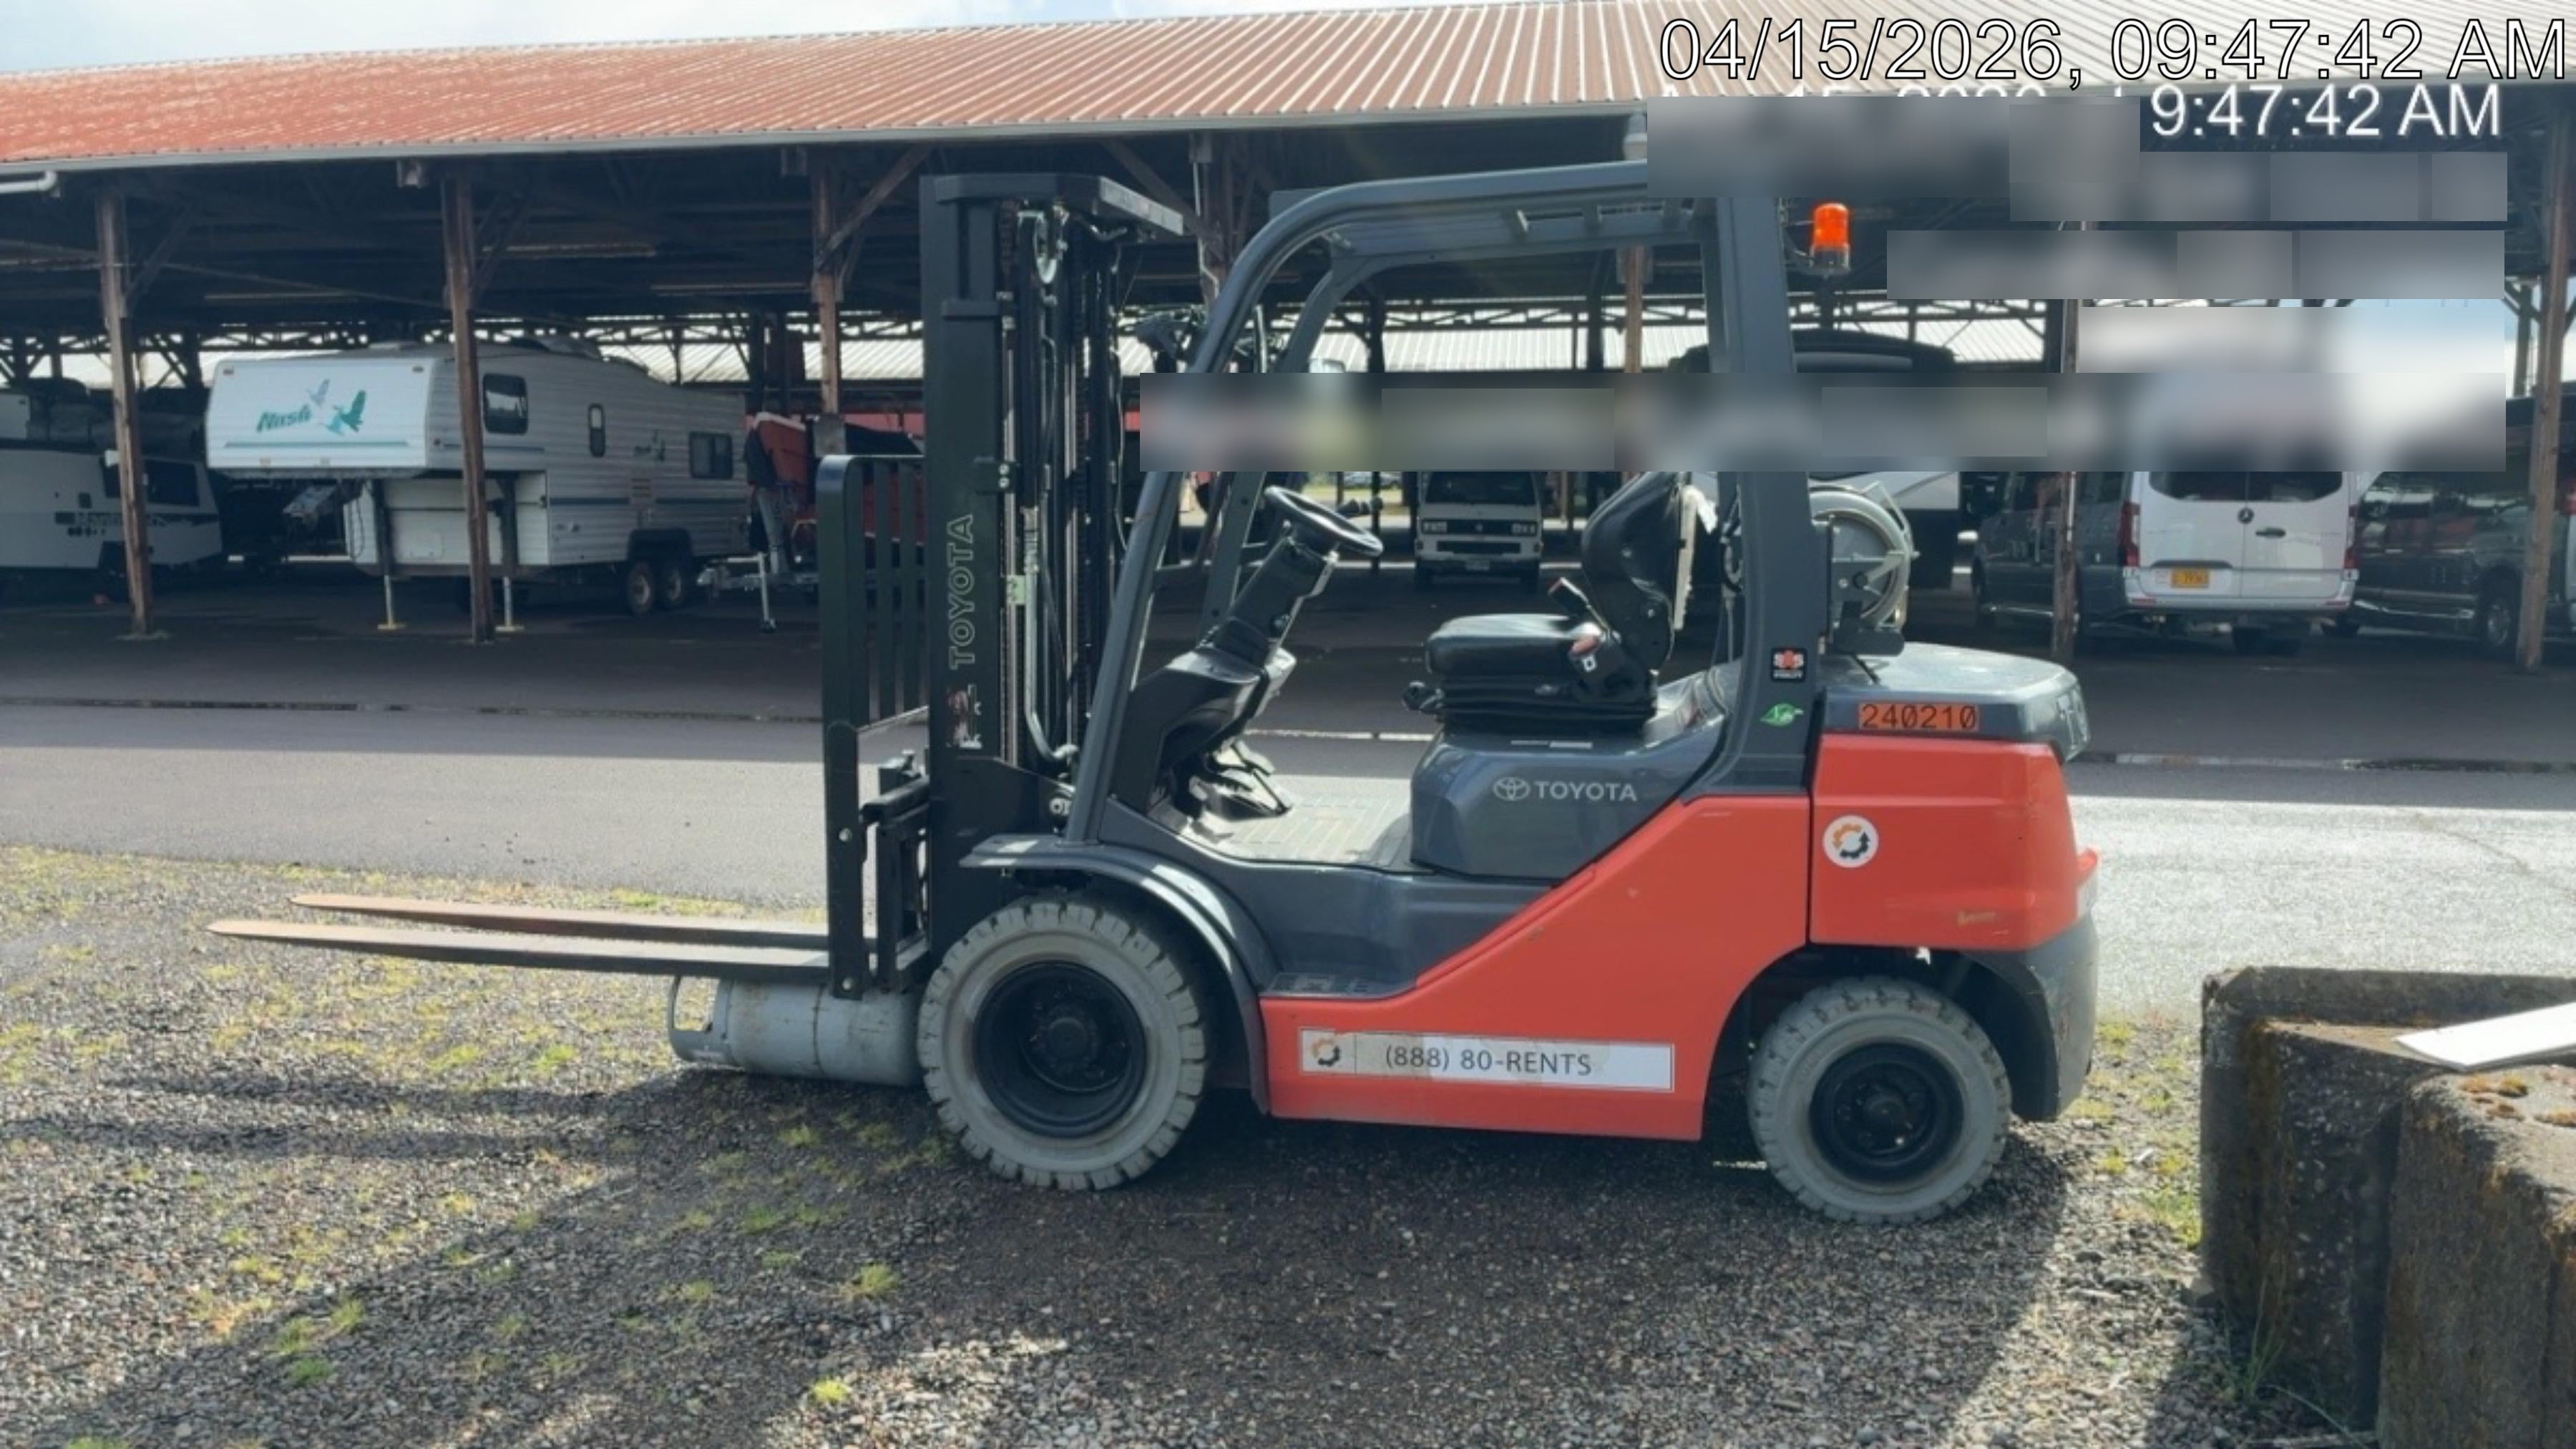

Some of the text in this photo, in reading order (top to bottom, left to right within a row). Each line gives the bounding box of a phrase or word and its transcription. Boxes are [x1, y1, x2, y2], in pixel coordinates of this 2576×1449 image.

[947, 514, 975, 670] TOYOTA
[1862, 703, 1976, 728] 240210
[1535, 781, 1636, 801] TOYOTA
[1386, 1045, 1591, 1075] (888) 80-RENTS
